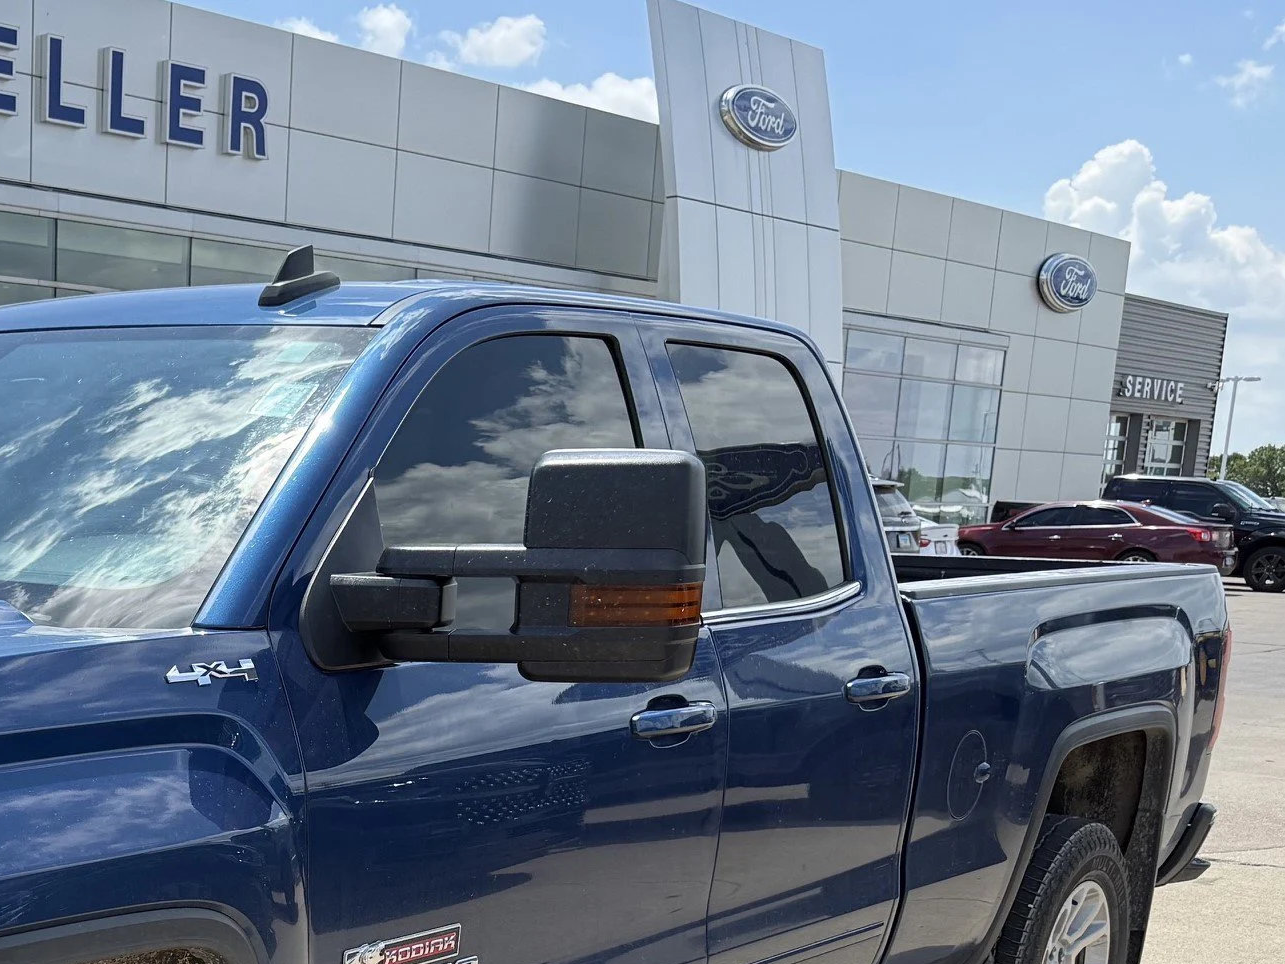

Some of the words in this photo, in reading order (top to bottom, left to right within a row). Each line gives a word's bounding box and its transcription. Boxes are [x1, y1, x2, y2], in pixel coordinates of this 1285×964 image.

[748, 96, 785, 135] Ford
[1060, 266, 1091, 299] Ford
[1125, 375, 1185, 403] SERVICE
